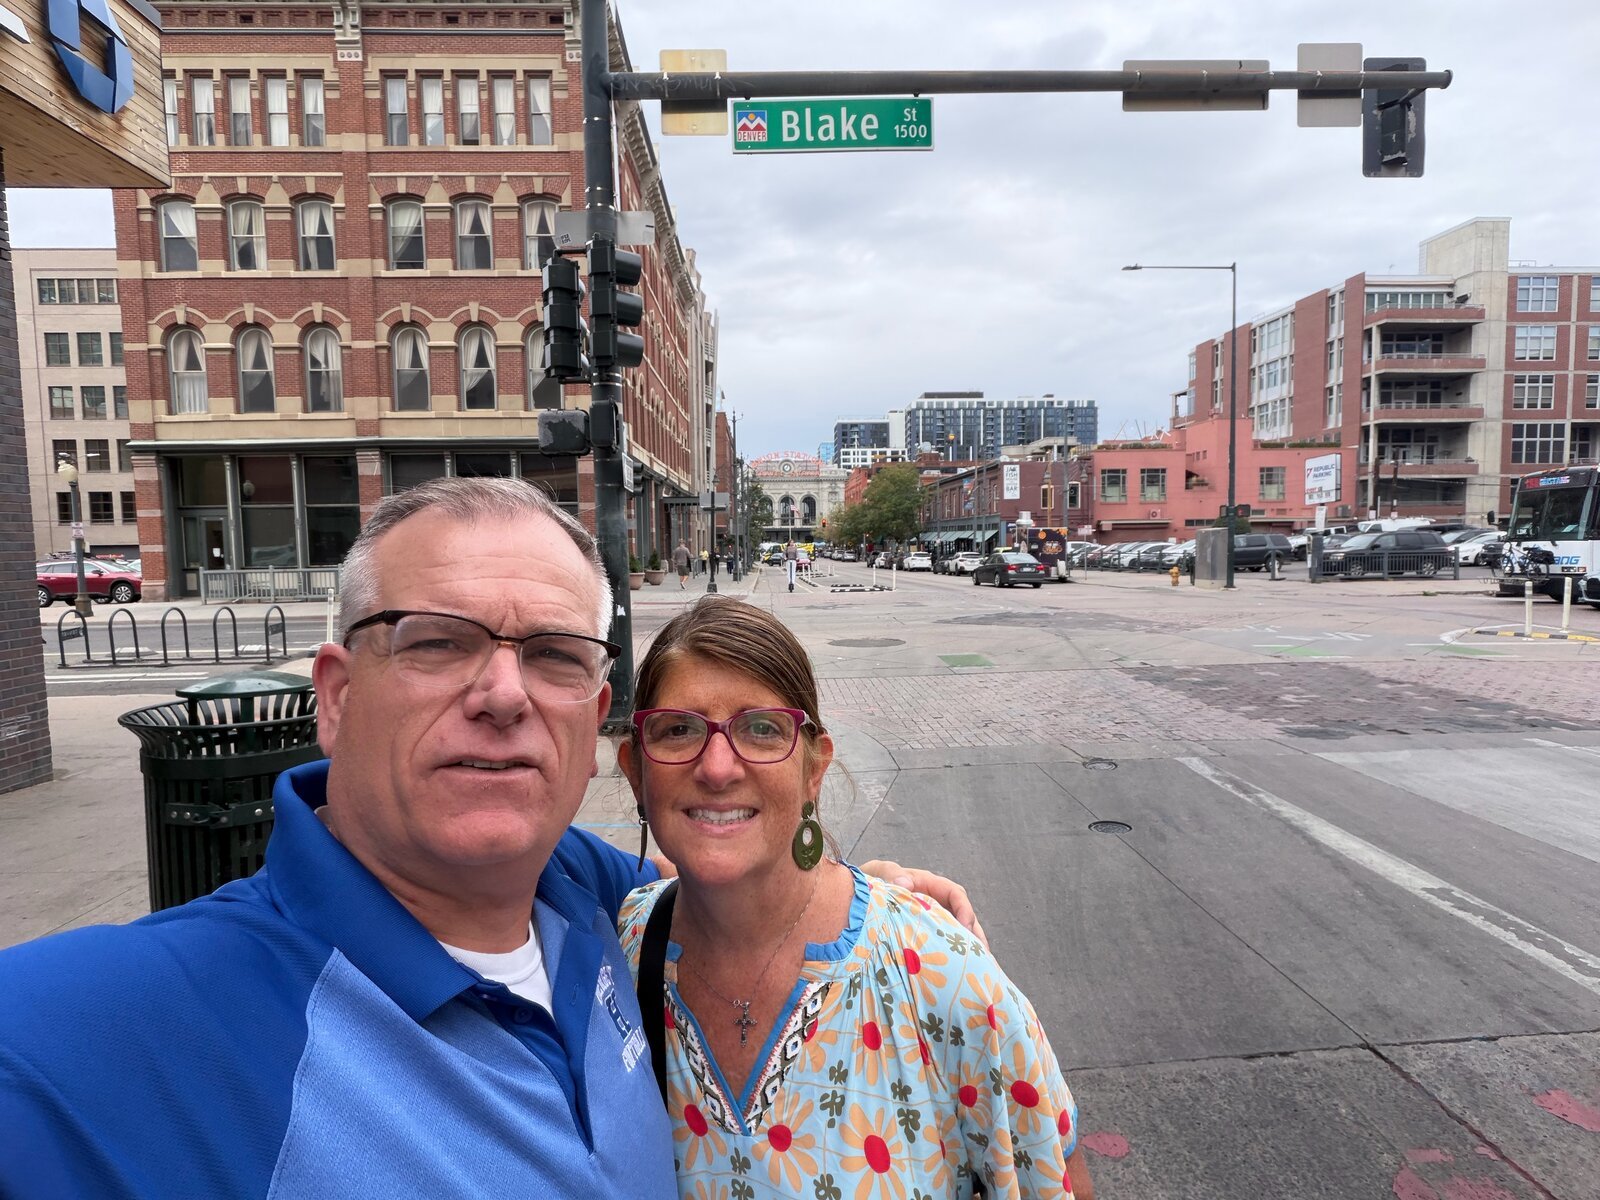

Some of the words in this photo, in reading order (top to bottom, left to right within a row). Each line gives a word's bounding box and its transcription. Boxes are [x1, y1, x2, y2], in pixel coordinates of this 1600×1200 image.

[903, 107, 917, 122] St
[781, 106, 879, 142] Blake
[894, 124, 927, 139] 1500
[737, 131, 767, 142] DENVER
[1313, 464, 1335, 472] REPUBLIC
